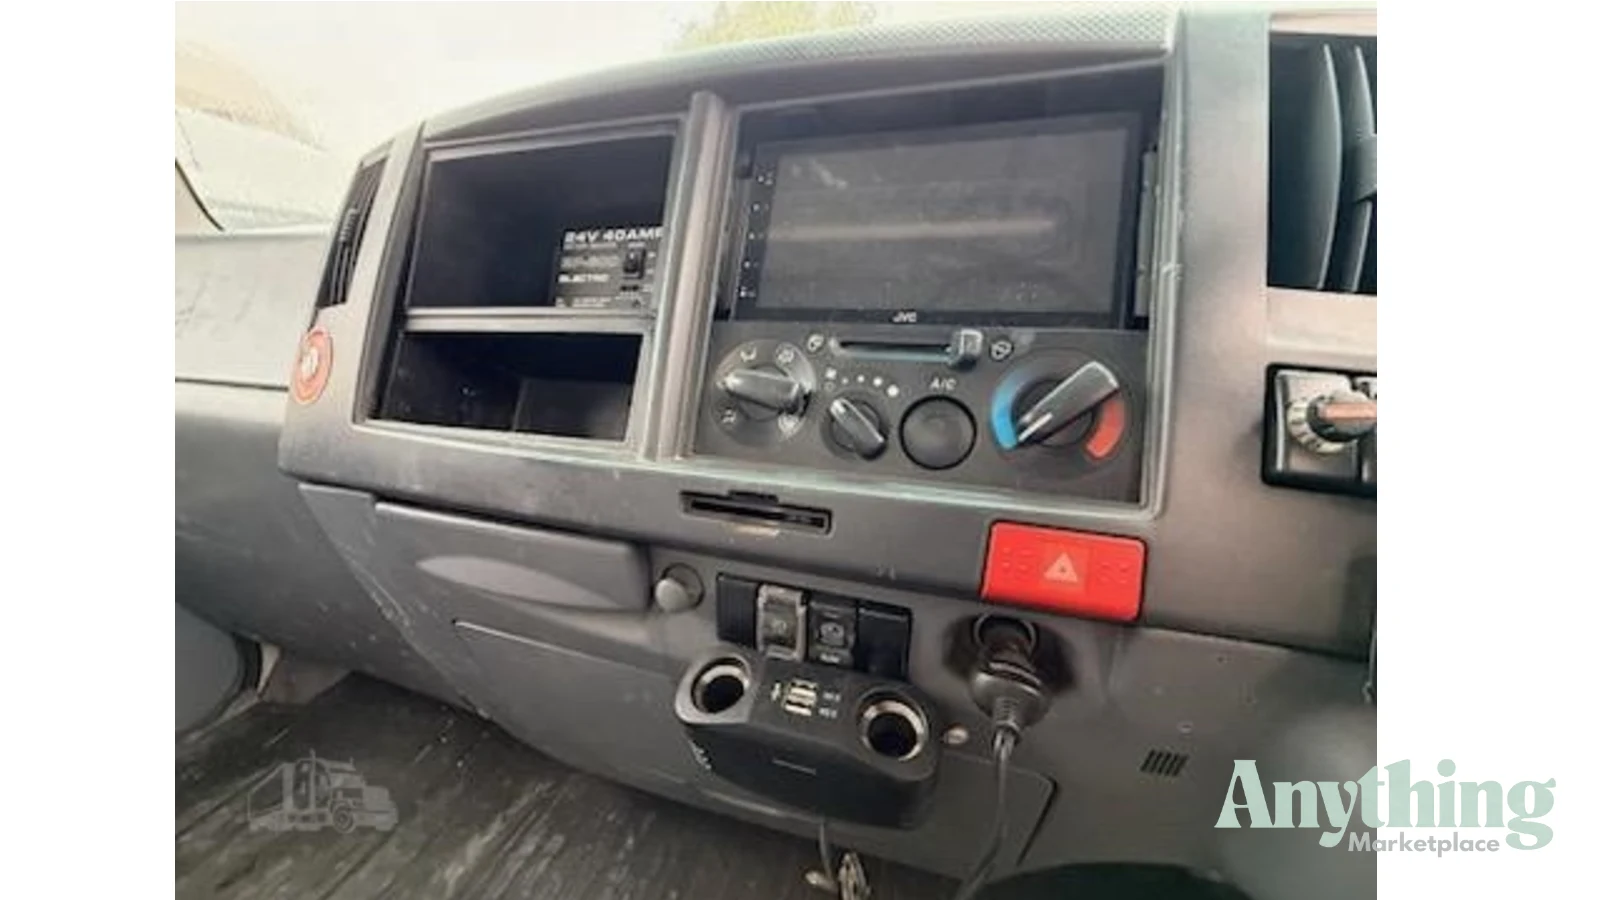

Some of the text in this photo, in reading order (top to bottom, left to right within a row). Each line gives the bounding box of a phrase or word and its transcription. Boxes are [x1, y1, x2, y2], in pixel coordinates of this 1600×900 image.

[564, 231, 599, 242] 24V
[893, 312, 917, 322] JVC
[929, 377, 956, 391] A/C
